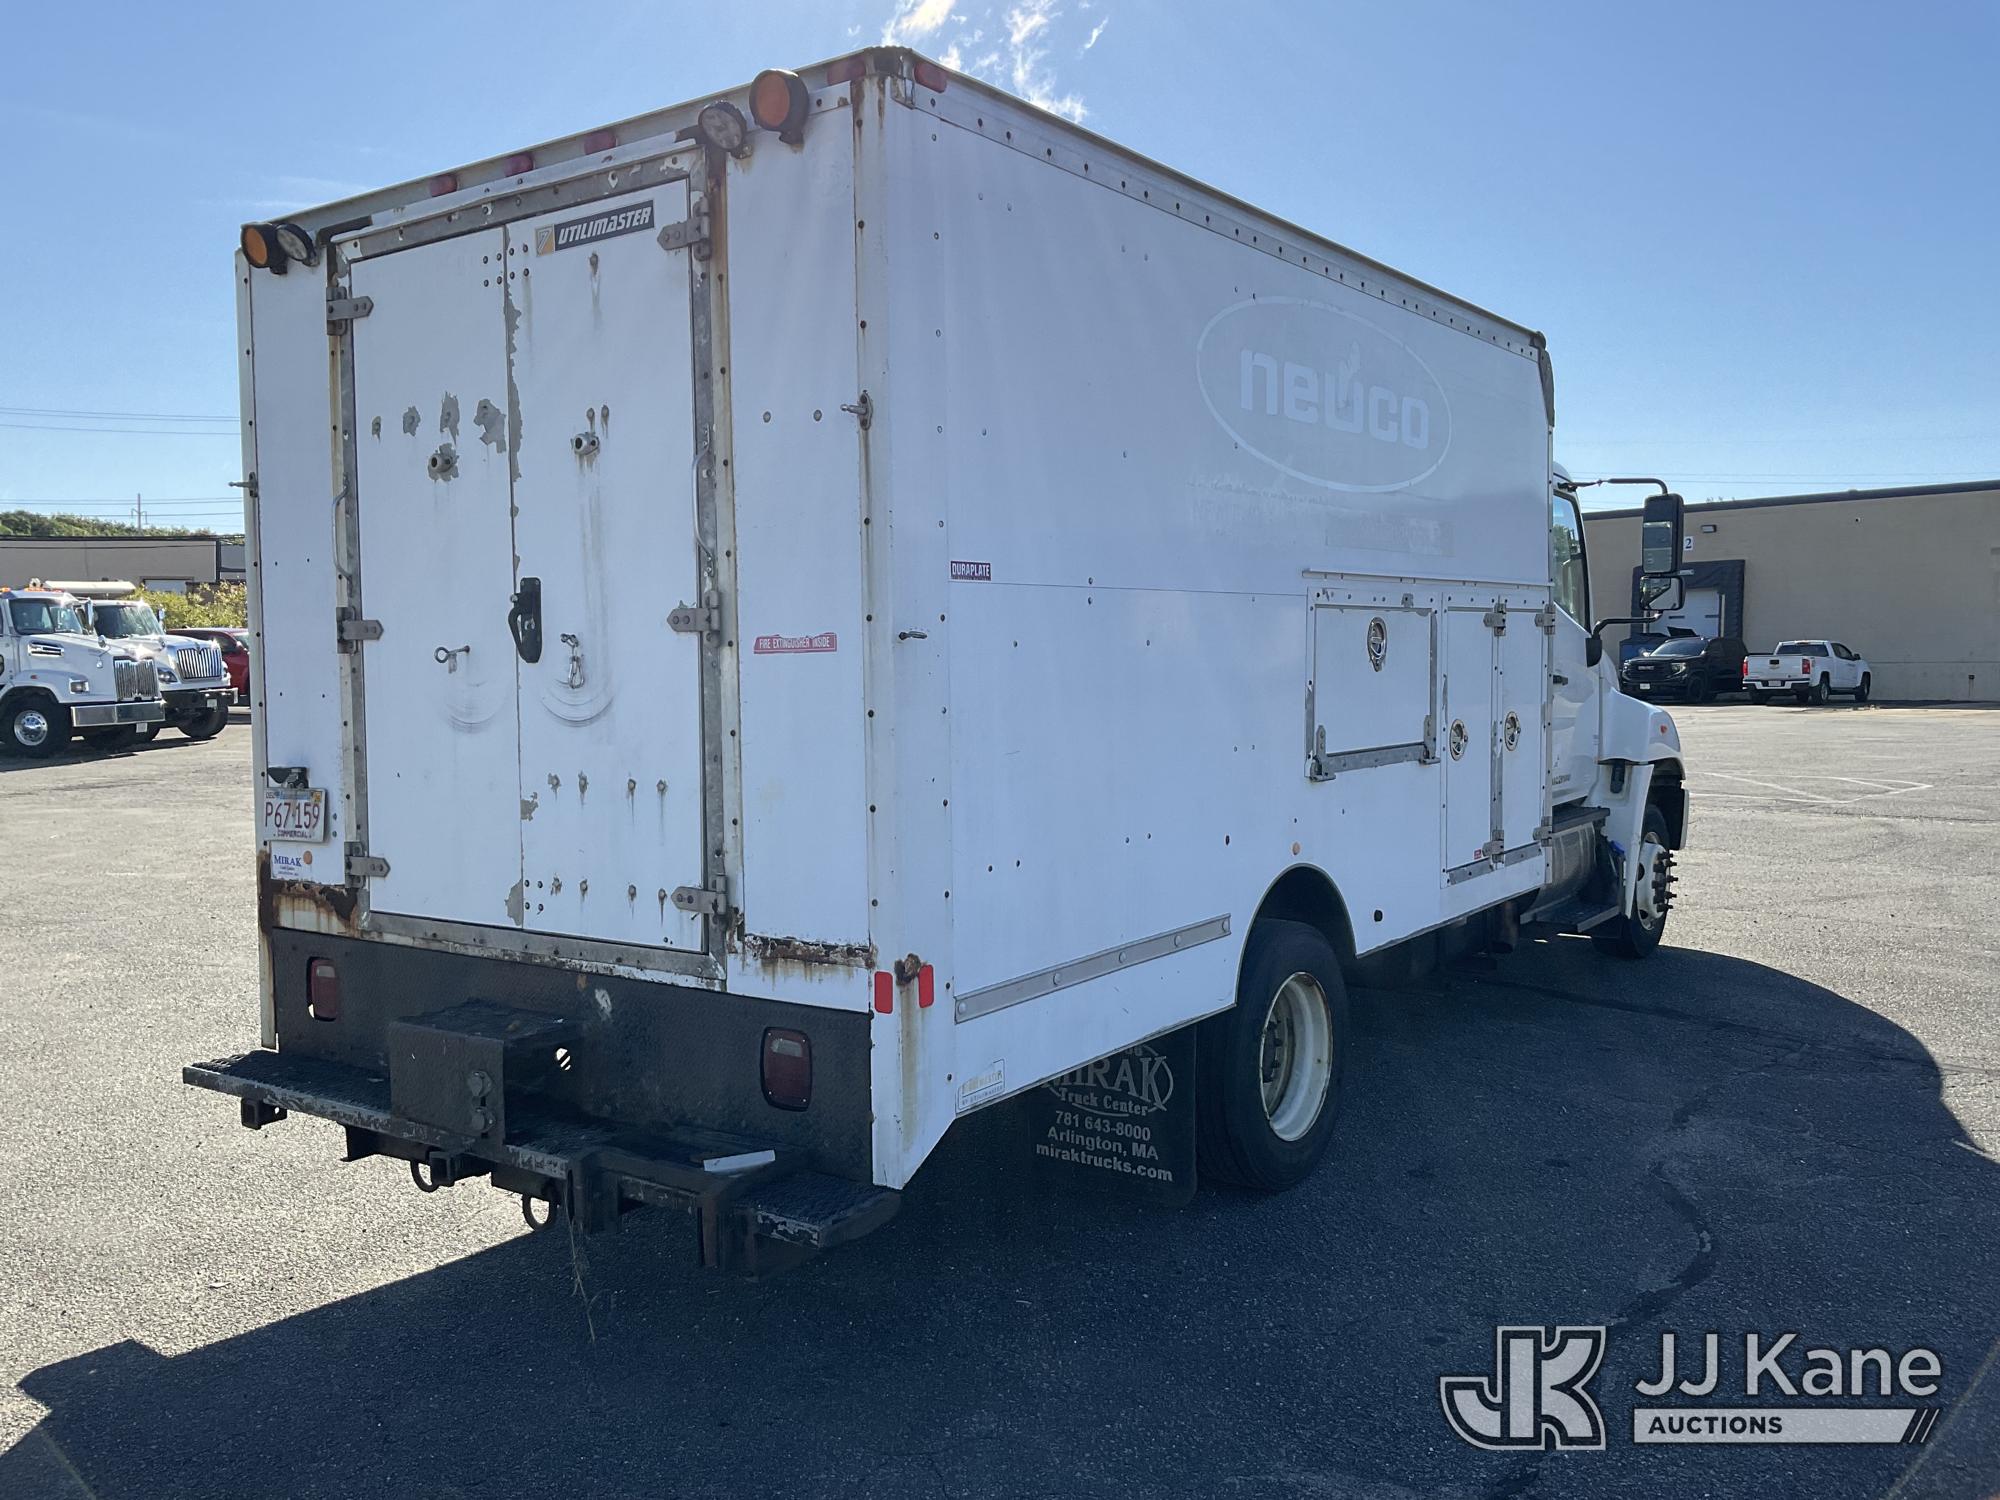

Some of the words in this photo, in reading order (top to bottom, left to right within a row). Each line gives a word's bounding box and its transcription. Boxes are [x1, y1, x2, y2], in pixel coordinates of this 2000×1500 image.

[952, 563, 990, 577] DURAPLATE
[760, 638, 770, 649] FIRE
[773, 638, 810, 649] EXTINGUISHER
[812, 636, 830, 649] INSIDE
[277, 830, 308, 839] COMMERCIAL
[273, 855, 302, 867] MIRAK
[1041, 1055, 1168, 1112] IRAK
[1058, 1087, 1098, 1107] Truck
[1103, 1095, 1149, 1117] Center
[1055, 1110, 1079, 1128] 781
[1084, 1116, 1151, 1142] 643-8000
[1047, 1126, 1128, 1157] Arlington,
[1132, 1142, 1159, 1161] MA
[1036, 1143, 1173, 1182] miraktrucks.com
